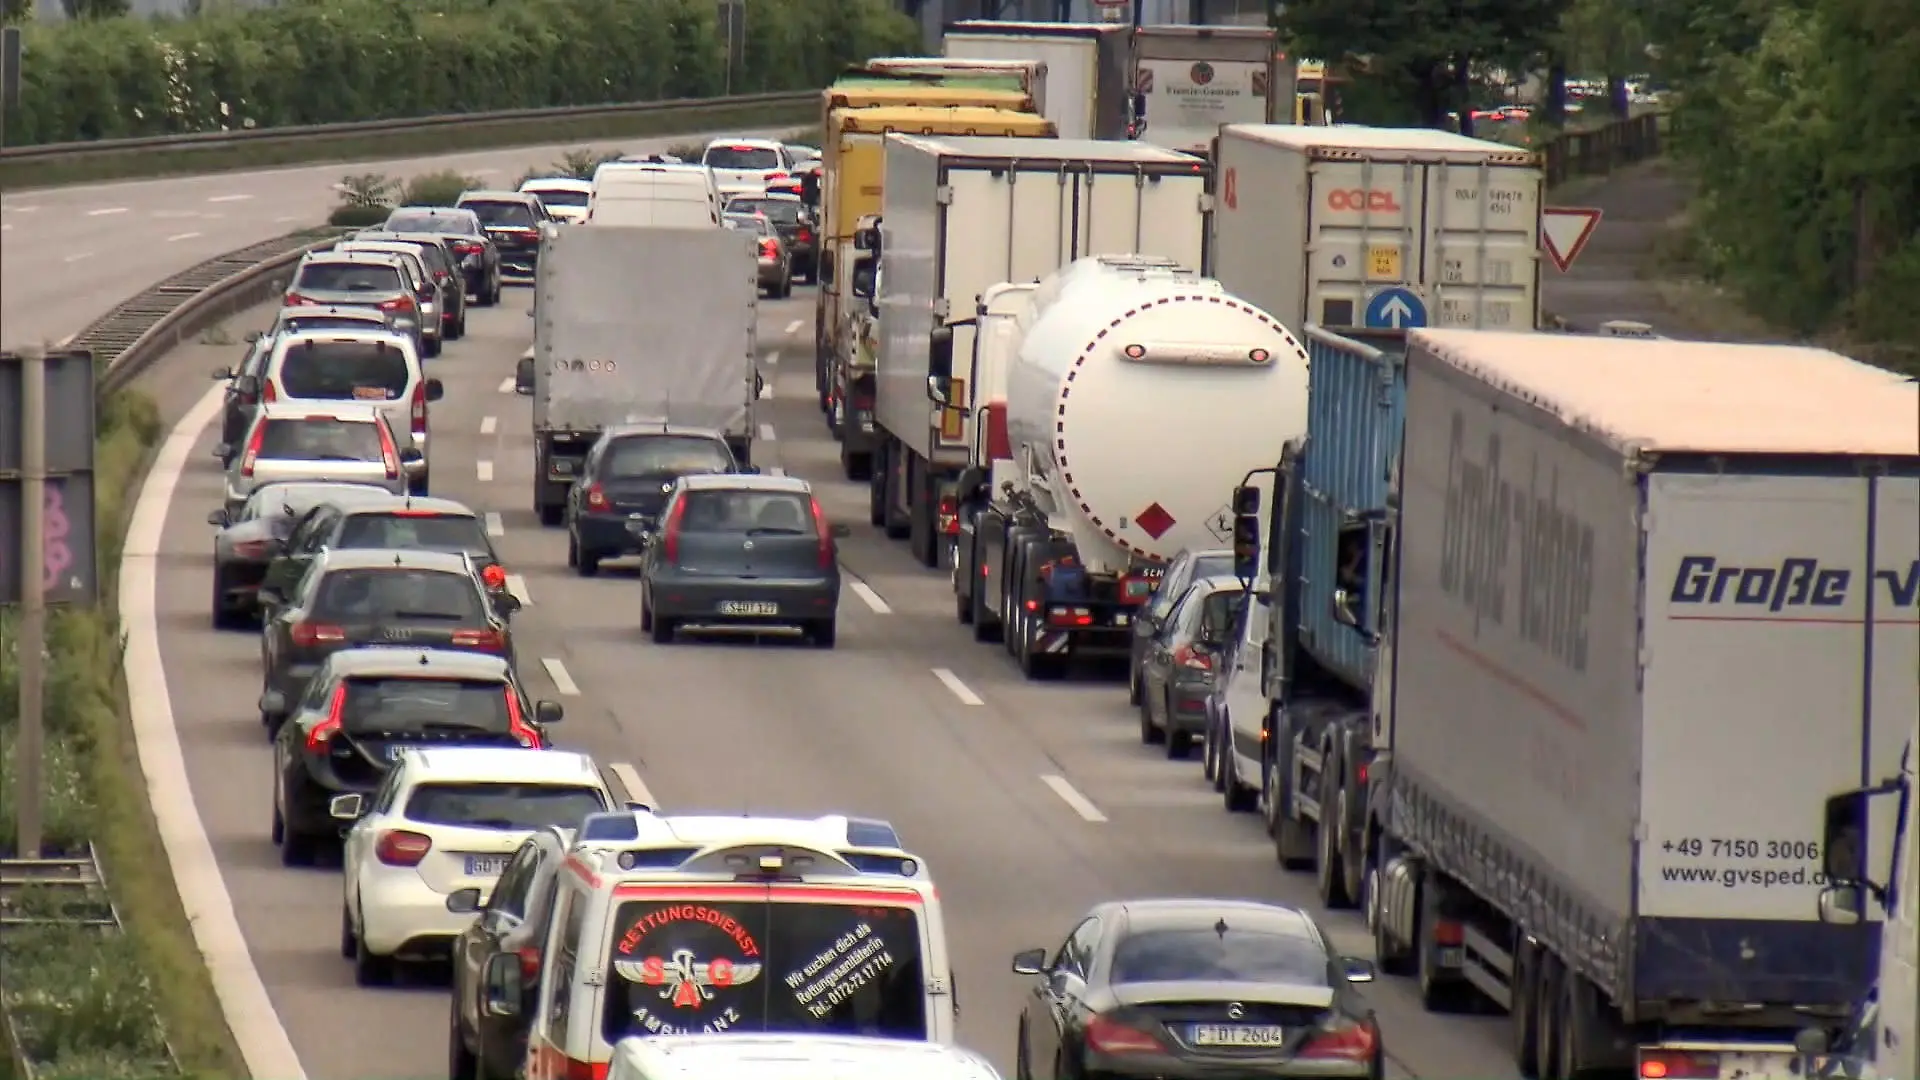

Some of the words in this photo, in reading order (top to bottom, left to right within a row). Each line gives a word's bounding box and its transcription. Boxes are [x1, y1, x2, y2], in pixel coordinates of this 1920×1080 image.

[1328, 189, 1400, 211] OOCL
[1670, 556, 1852, 612] Große
[1662, 839, 1703, 857] +49
[1711, 839, 1759, 858] 7150
[618, 904, 760, 957] RETTUNGSDIENST
[785, 972, 805, 989] Wir
[803, 949, 838, 977] suchen
[836, 932, 858, 953] dich
[862, 964, 876, 979] 17
[873, 951, 894, 971] 714
